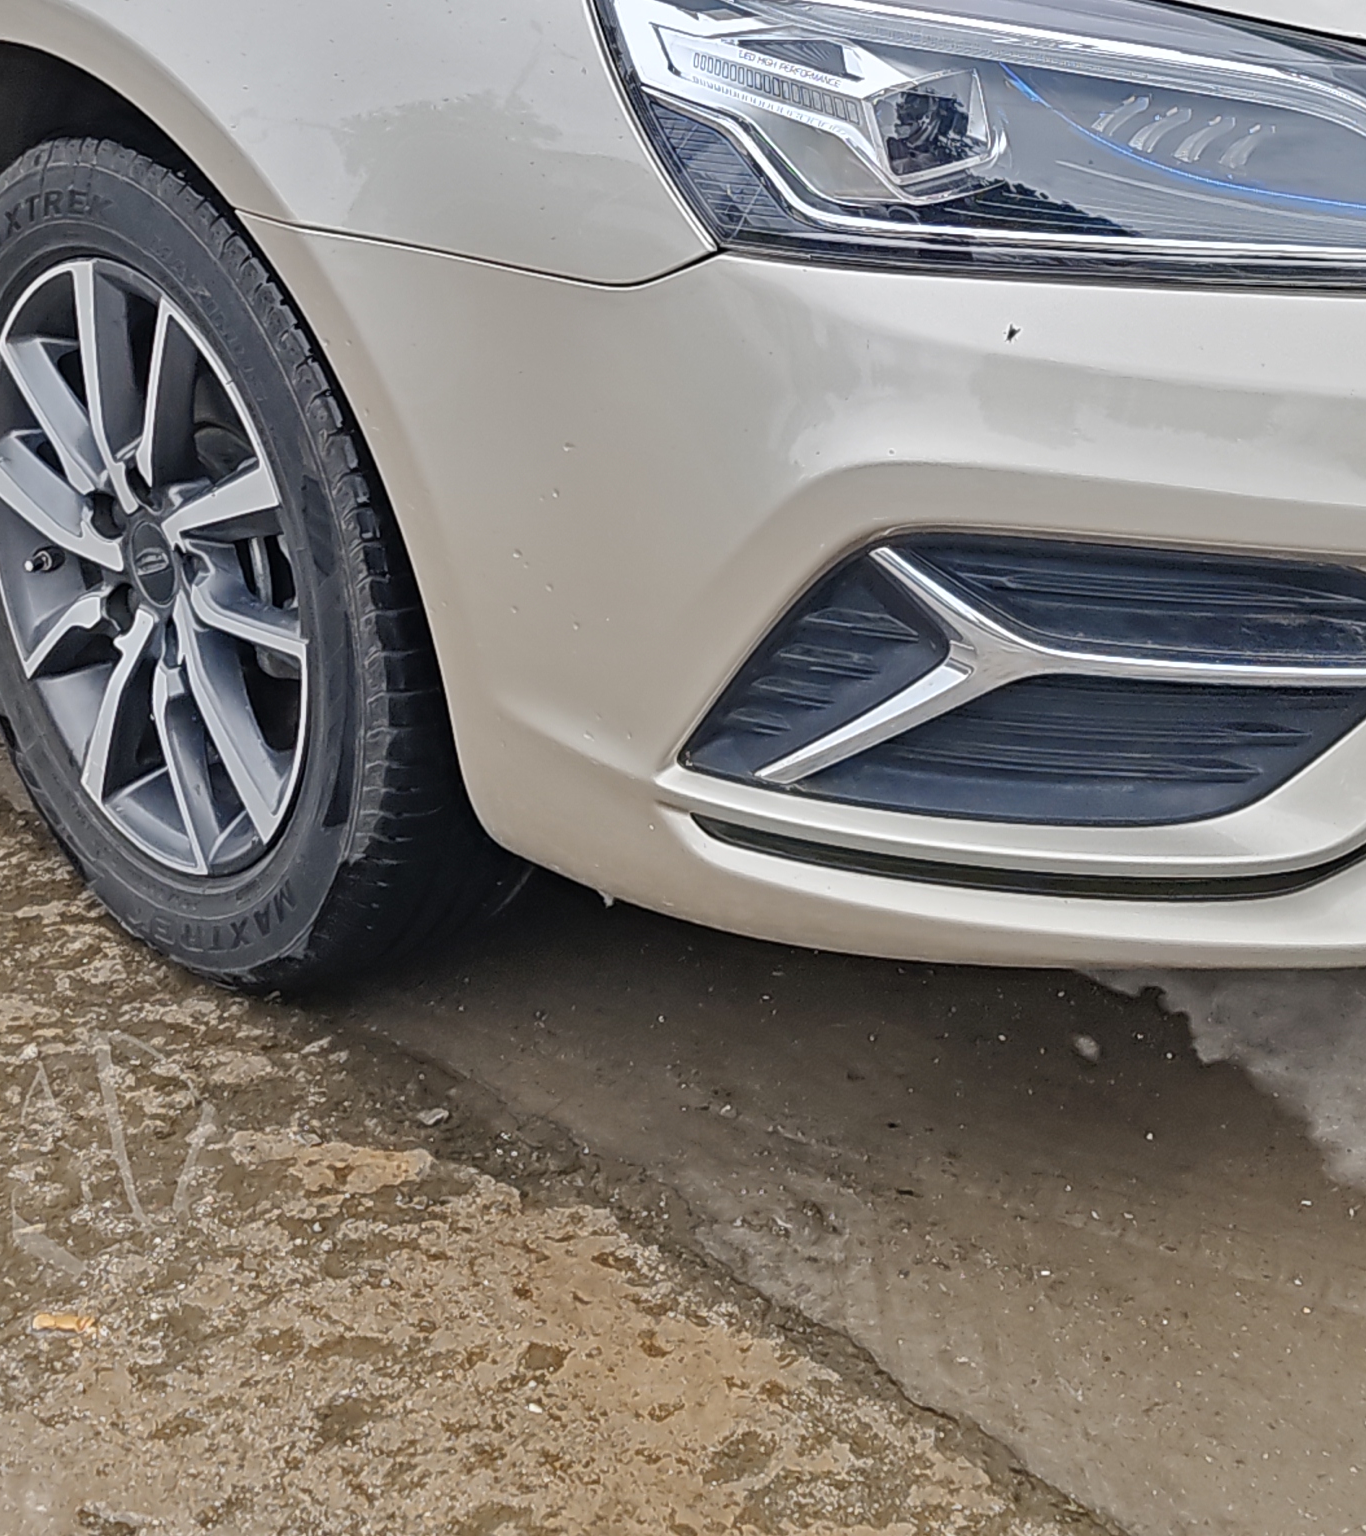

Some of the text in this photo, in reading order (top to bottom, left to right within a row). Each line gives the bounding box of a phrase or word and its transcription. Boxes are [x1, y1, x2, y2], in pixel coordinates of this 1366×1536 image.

[739, 50, 841, 88] LED HIGH PERFORMANCE
